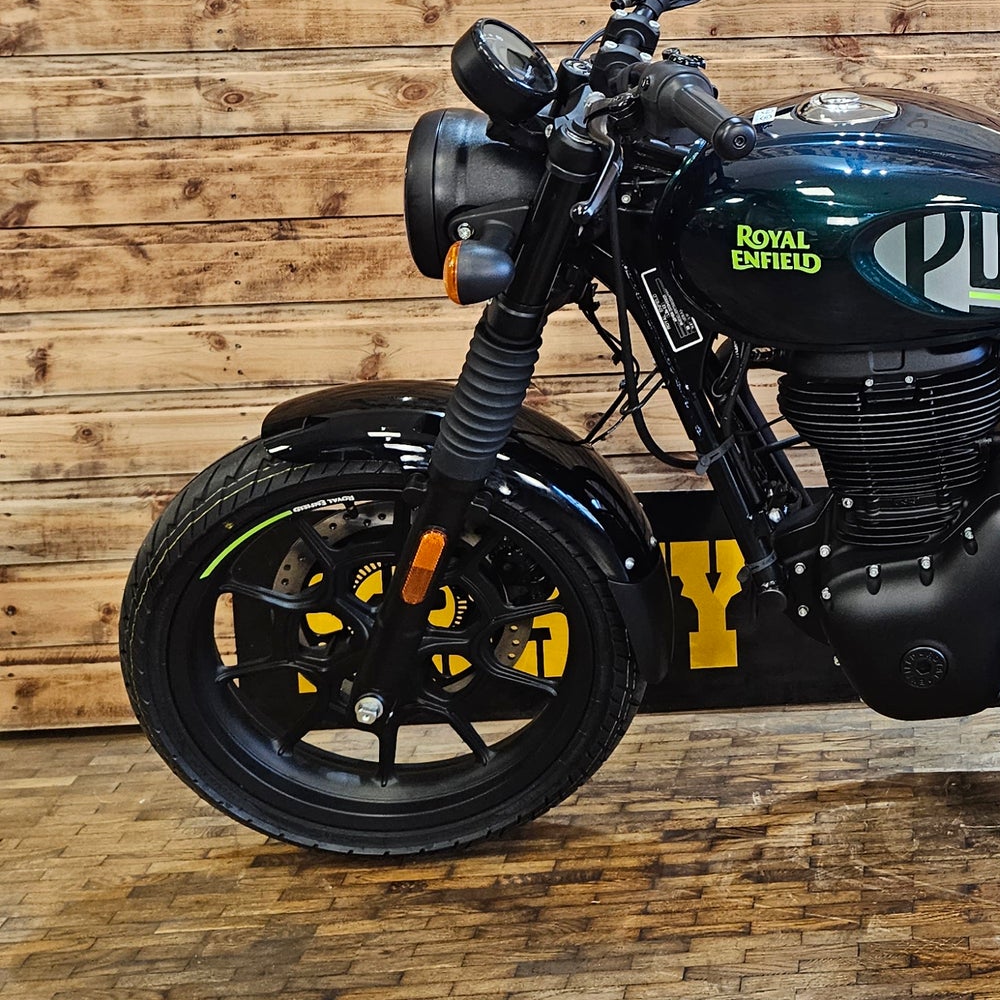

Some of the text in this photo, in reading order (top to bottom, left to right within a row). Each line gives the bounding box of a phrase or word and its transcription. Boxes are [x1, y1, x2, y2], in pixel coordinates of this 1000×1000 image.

[736, 224, 810, 250] ROYAL
[731, 249, 821, 274] ENFIELD
[327, 495, 355, 504] ROYAL
